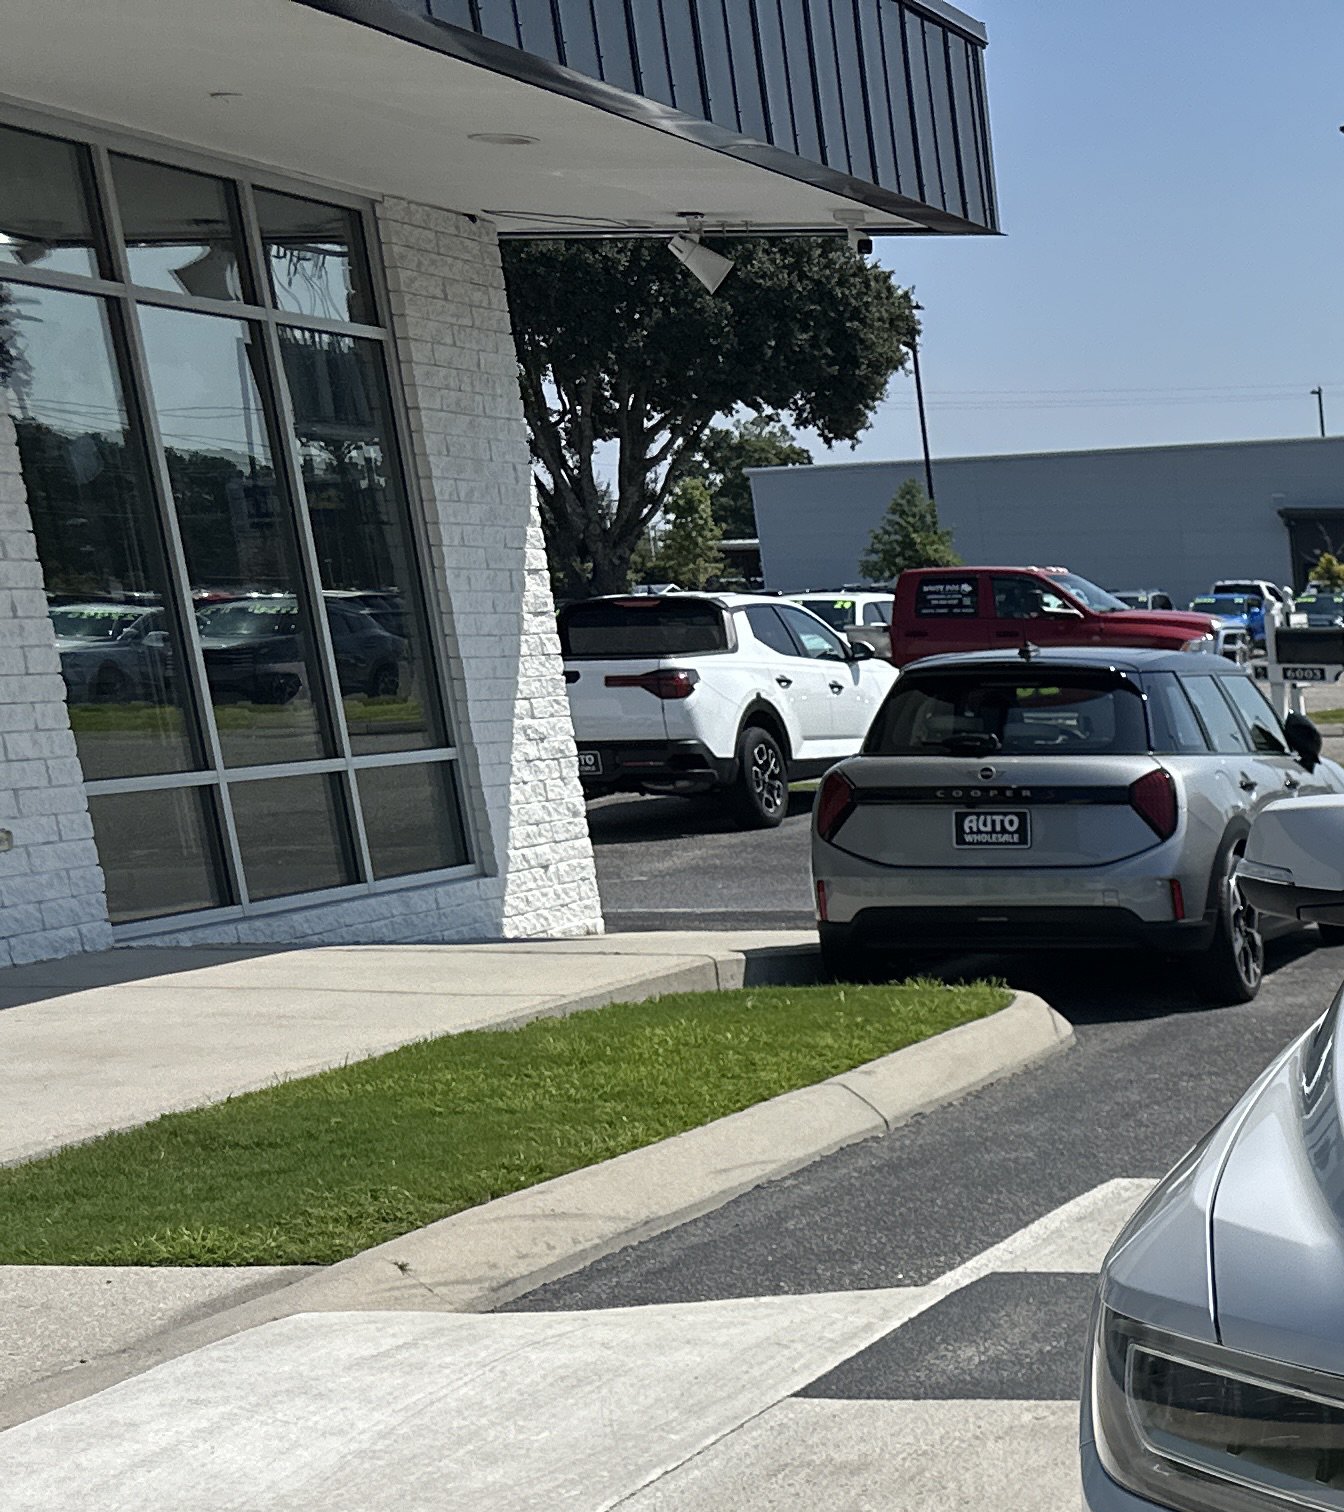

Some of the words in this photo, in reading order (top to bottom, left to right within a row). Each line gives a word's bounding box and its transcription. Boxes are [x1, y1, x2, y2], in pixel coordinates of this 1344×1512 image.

[936, 790, 1032, 798] COOPER
[963, 815, 1020, 833] AUTO
[963, 833, 1020, 843] WHOLESALE
